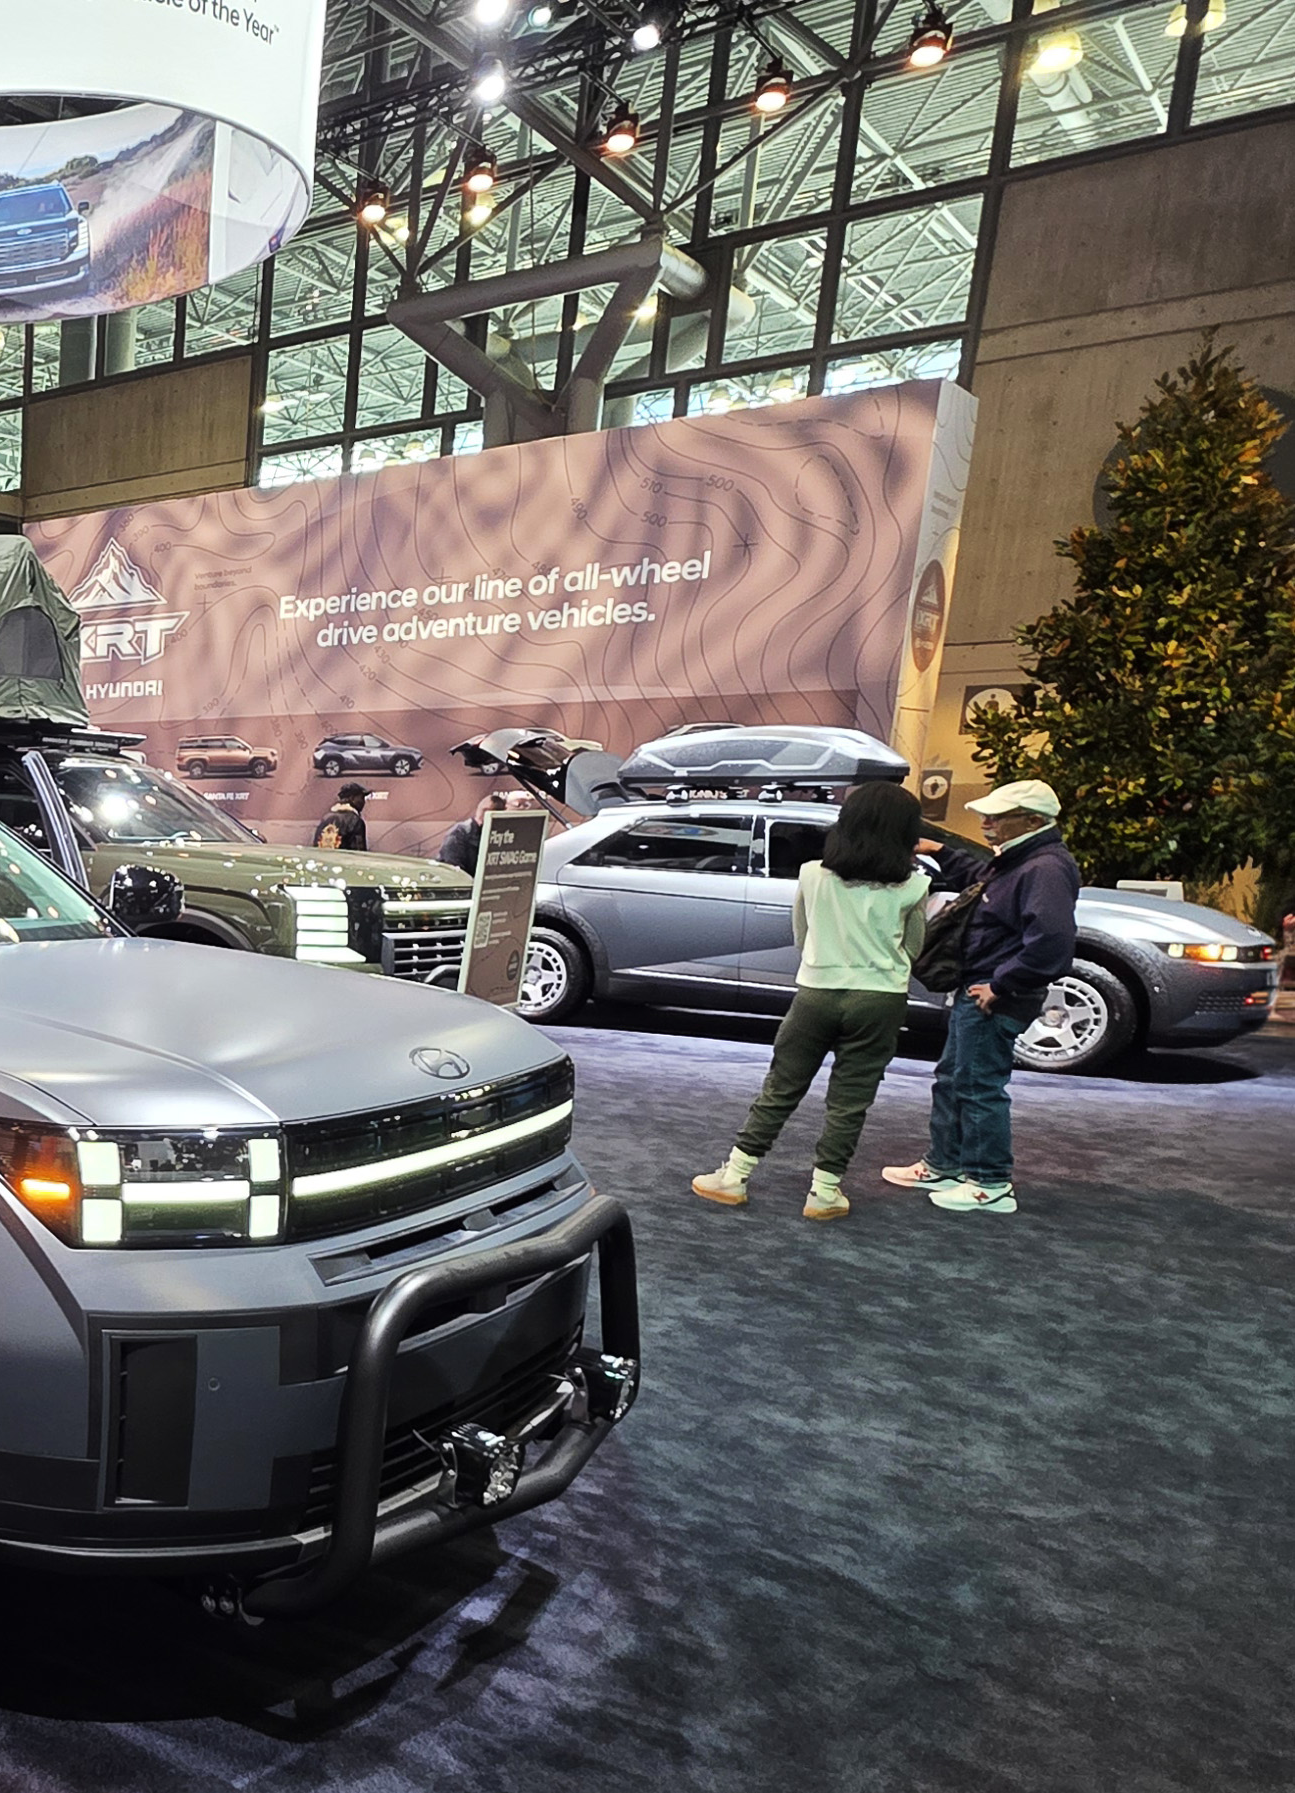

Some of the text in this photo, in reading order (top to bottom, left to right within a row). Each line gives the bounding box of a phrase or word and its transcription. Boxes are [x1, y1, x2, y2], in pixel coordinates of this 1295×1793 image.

[212, 0, 240, 27] the
[639, 477, 664, 495] 510
[705, 474, 735, 493] 500
[570, 496, 589, 521] 490
[640, 510, 668, 528] 500
[224, 566, 253, 577] beyond
[279, 586, 419, 621] Experience
[423, 581, 469, 605] our
[473, 573, 523, 600] line
[528, 566, 560, 597] of
[564, 550, 711, 592] all-wheel
[316, 598, 656, 647] drive adventure vehicles.
[85, 680, 163, 700] HYUNDAI
